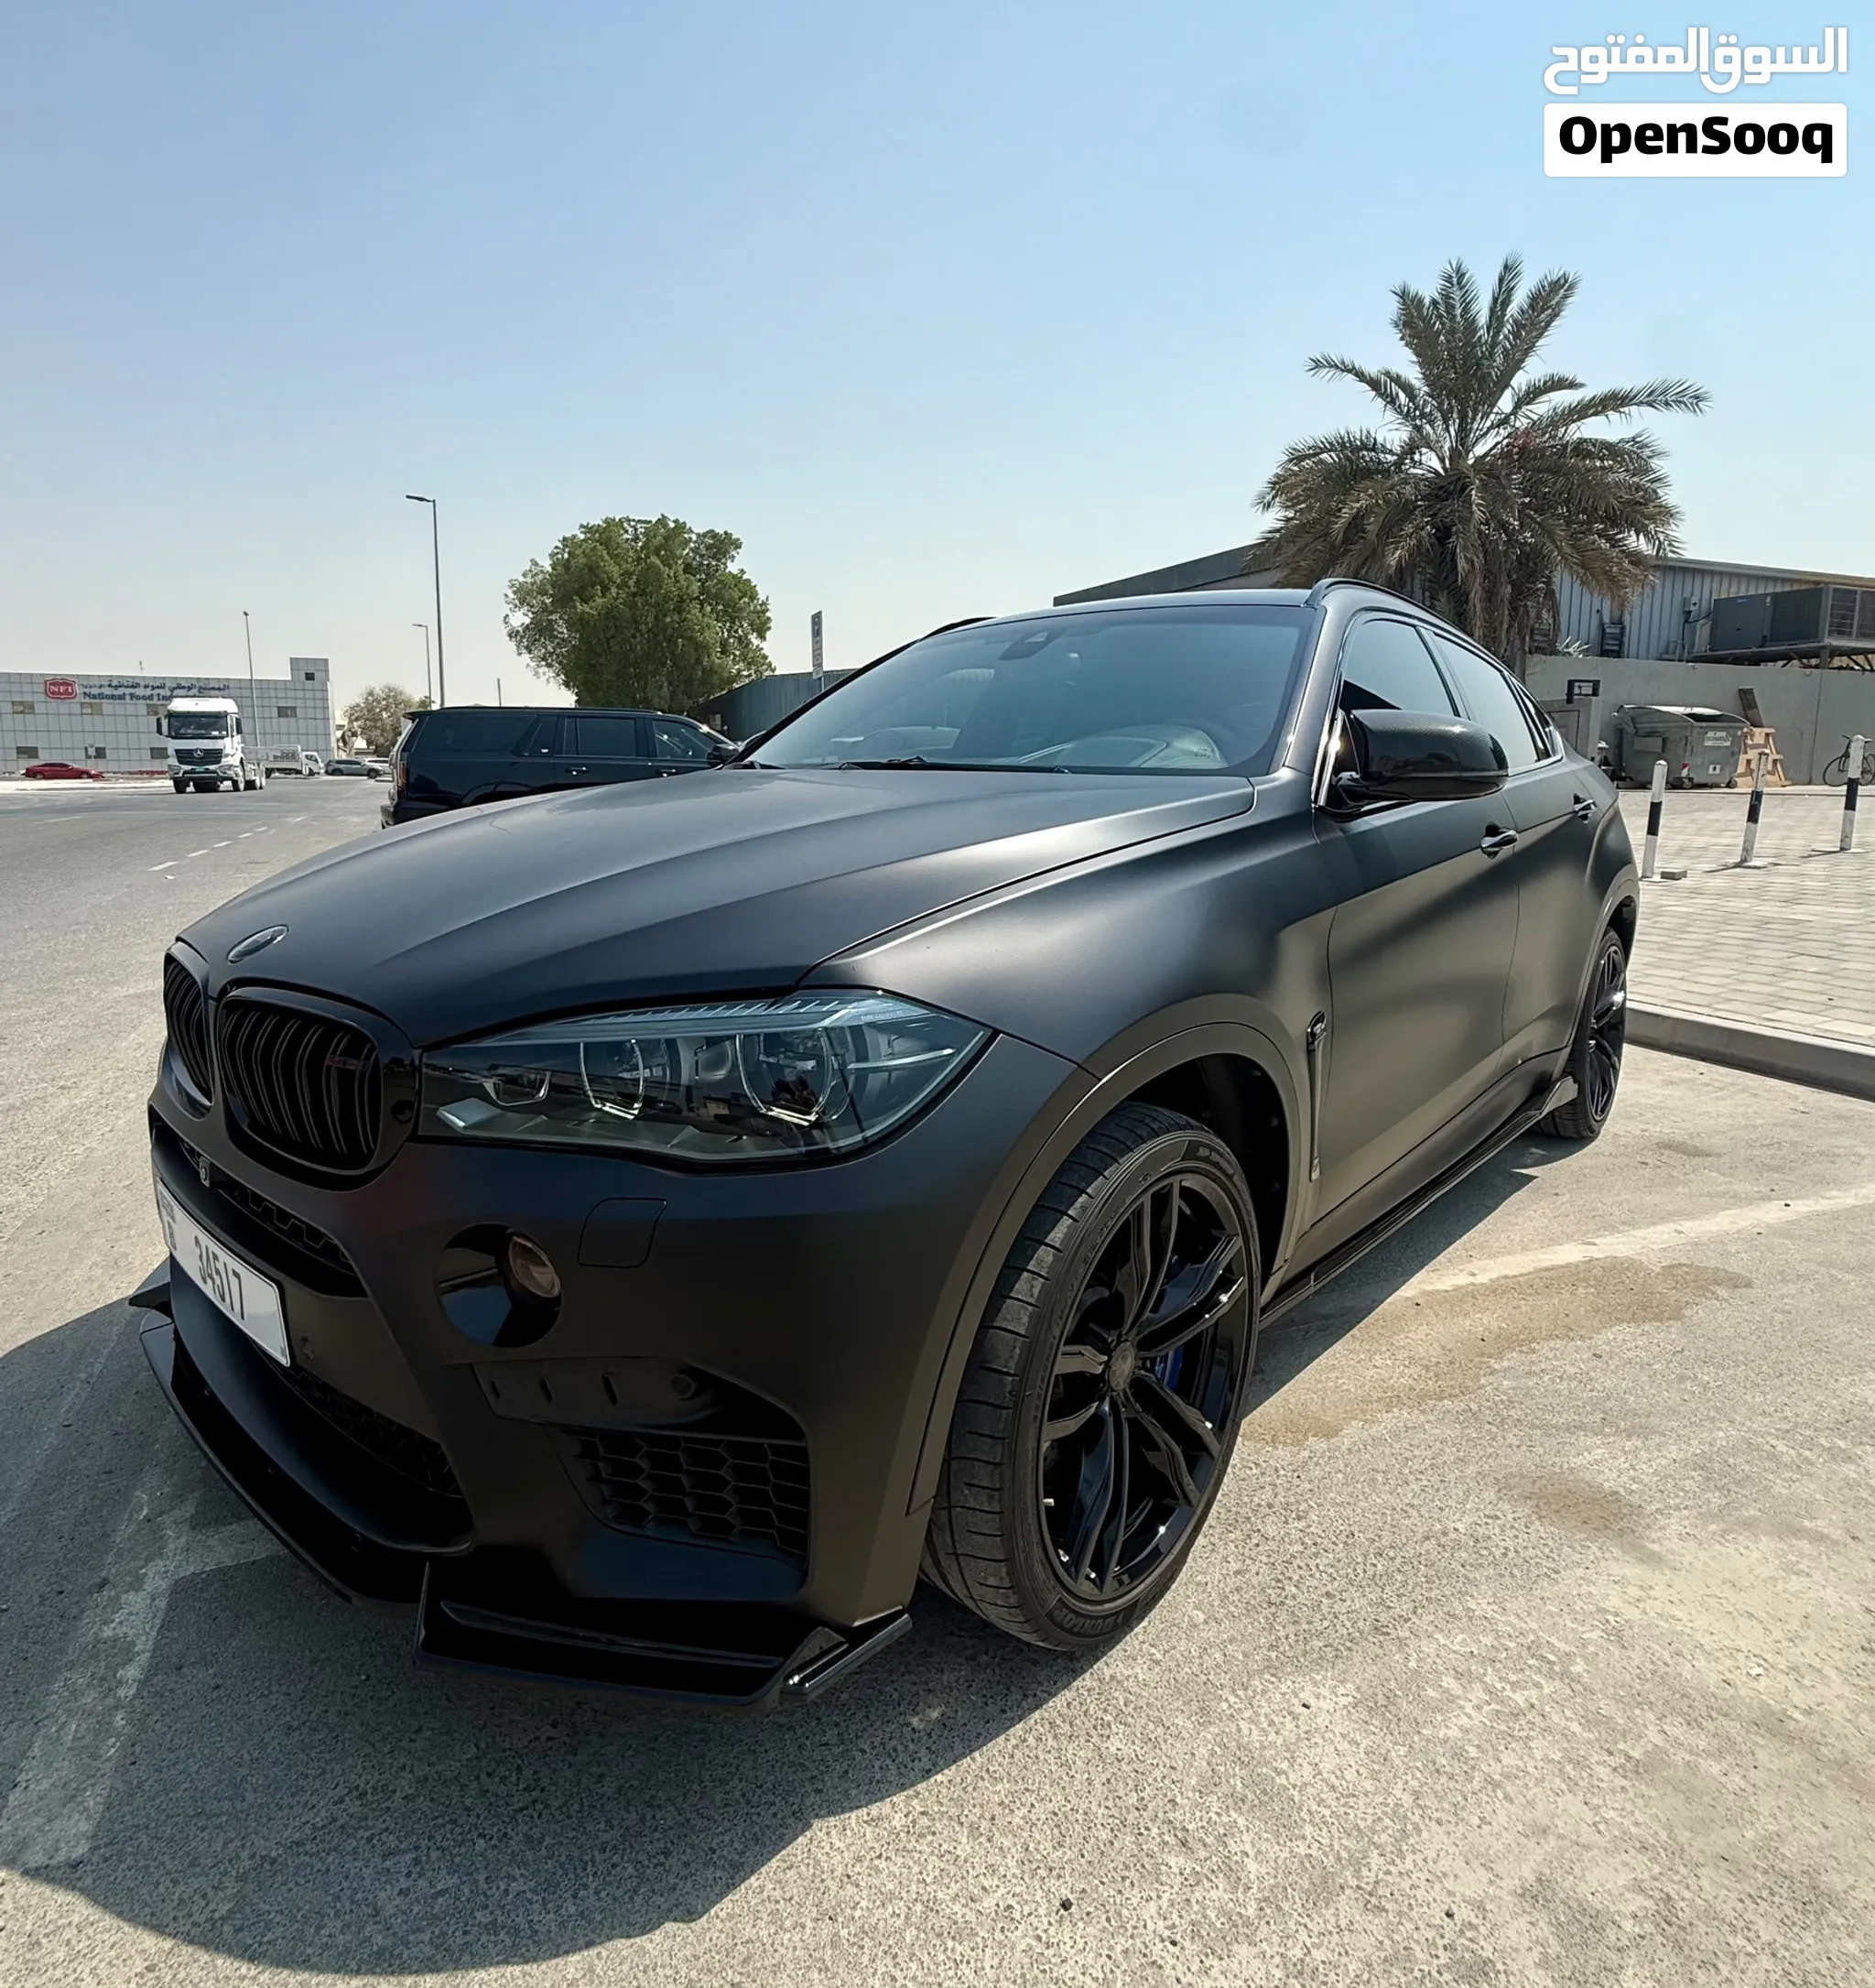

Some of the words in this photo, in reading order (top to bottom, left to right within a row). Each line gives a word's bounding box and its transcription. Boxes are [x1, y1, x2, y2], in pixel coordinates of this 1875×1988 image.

[83, 691, 126, 701] National
[129, 692, 154, 701] Food
[194, 1235, 244, 1320] 34517
